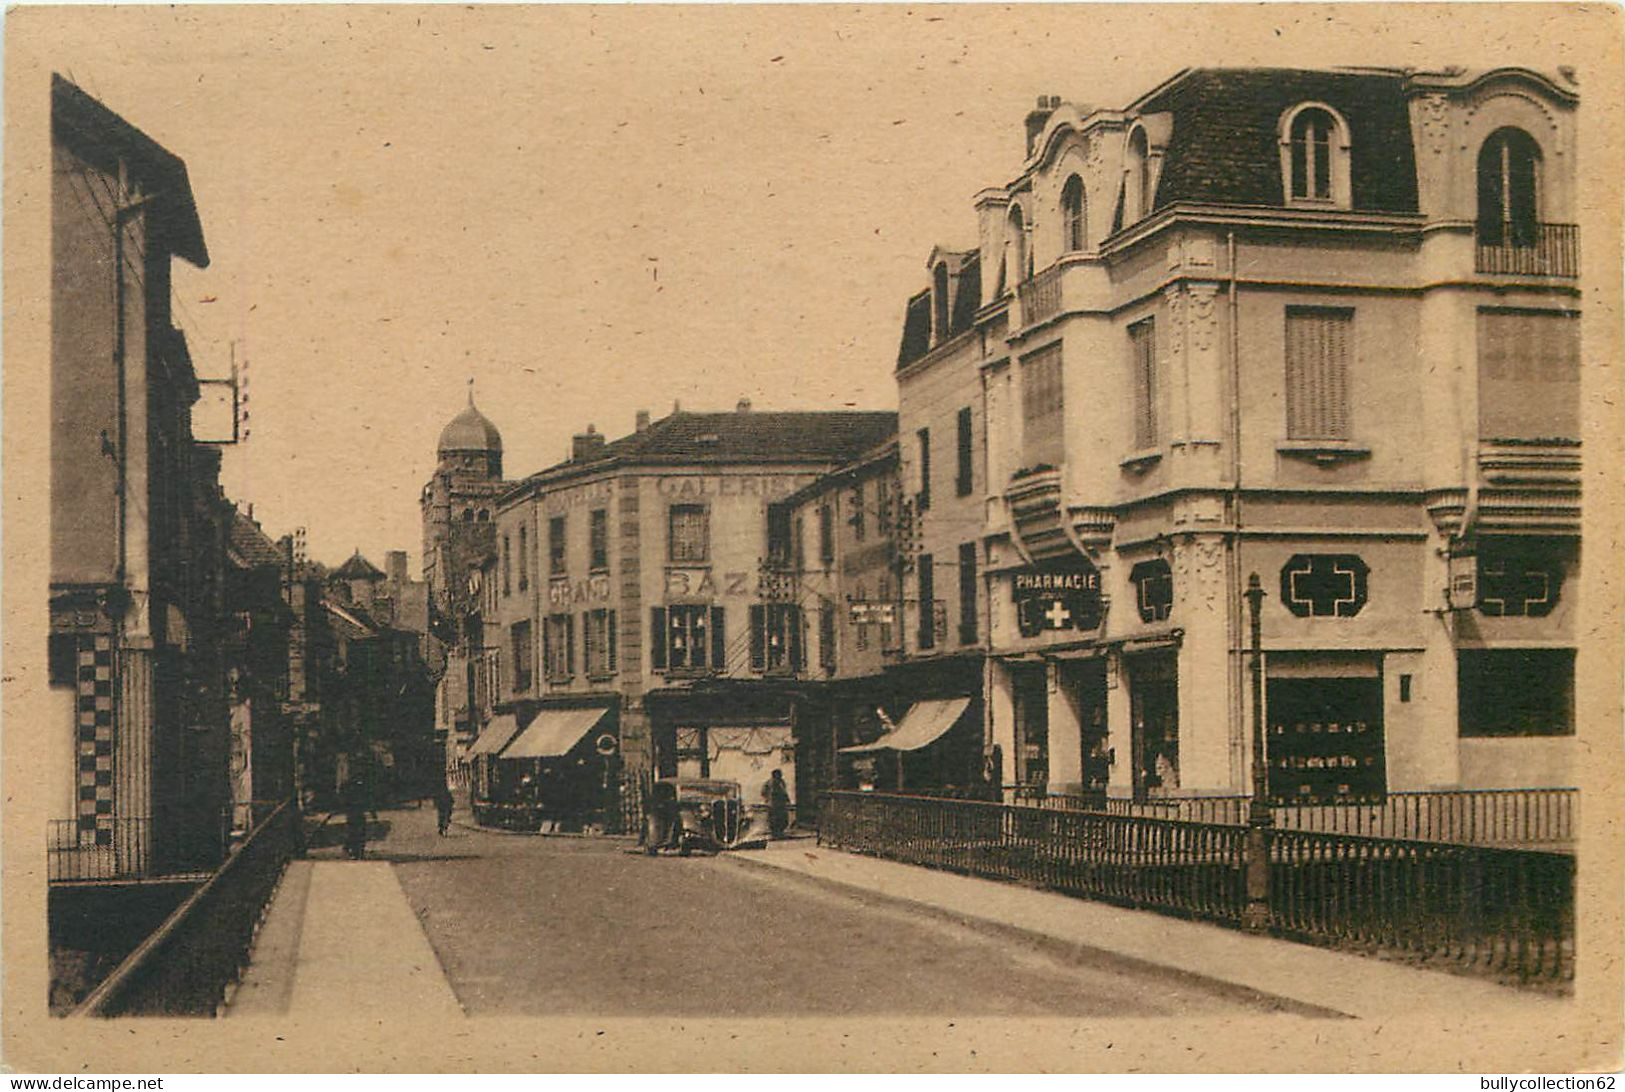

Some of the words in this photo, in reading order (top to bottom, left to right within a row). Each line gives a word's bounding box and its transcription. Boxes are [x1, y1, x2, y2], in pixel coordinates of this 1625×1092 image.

[549, 576, 609, 606] GRAND
[663, 570, 794, 597] BAZ
[1016, 573, 1098, 590] PHARMACIE
